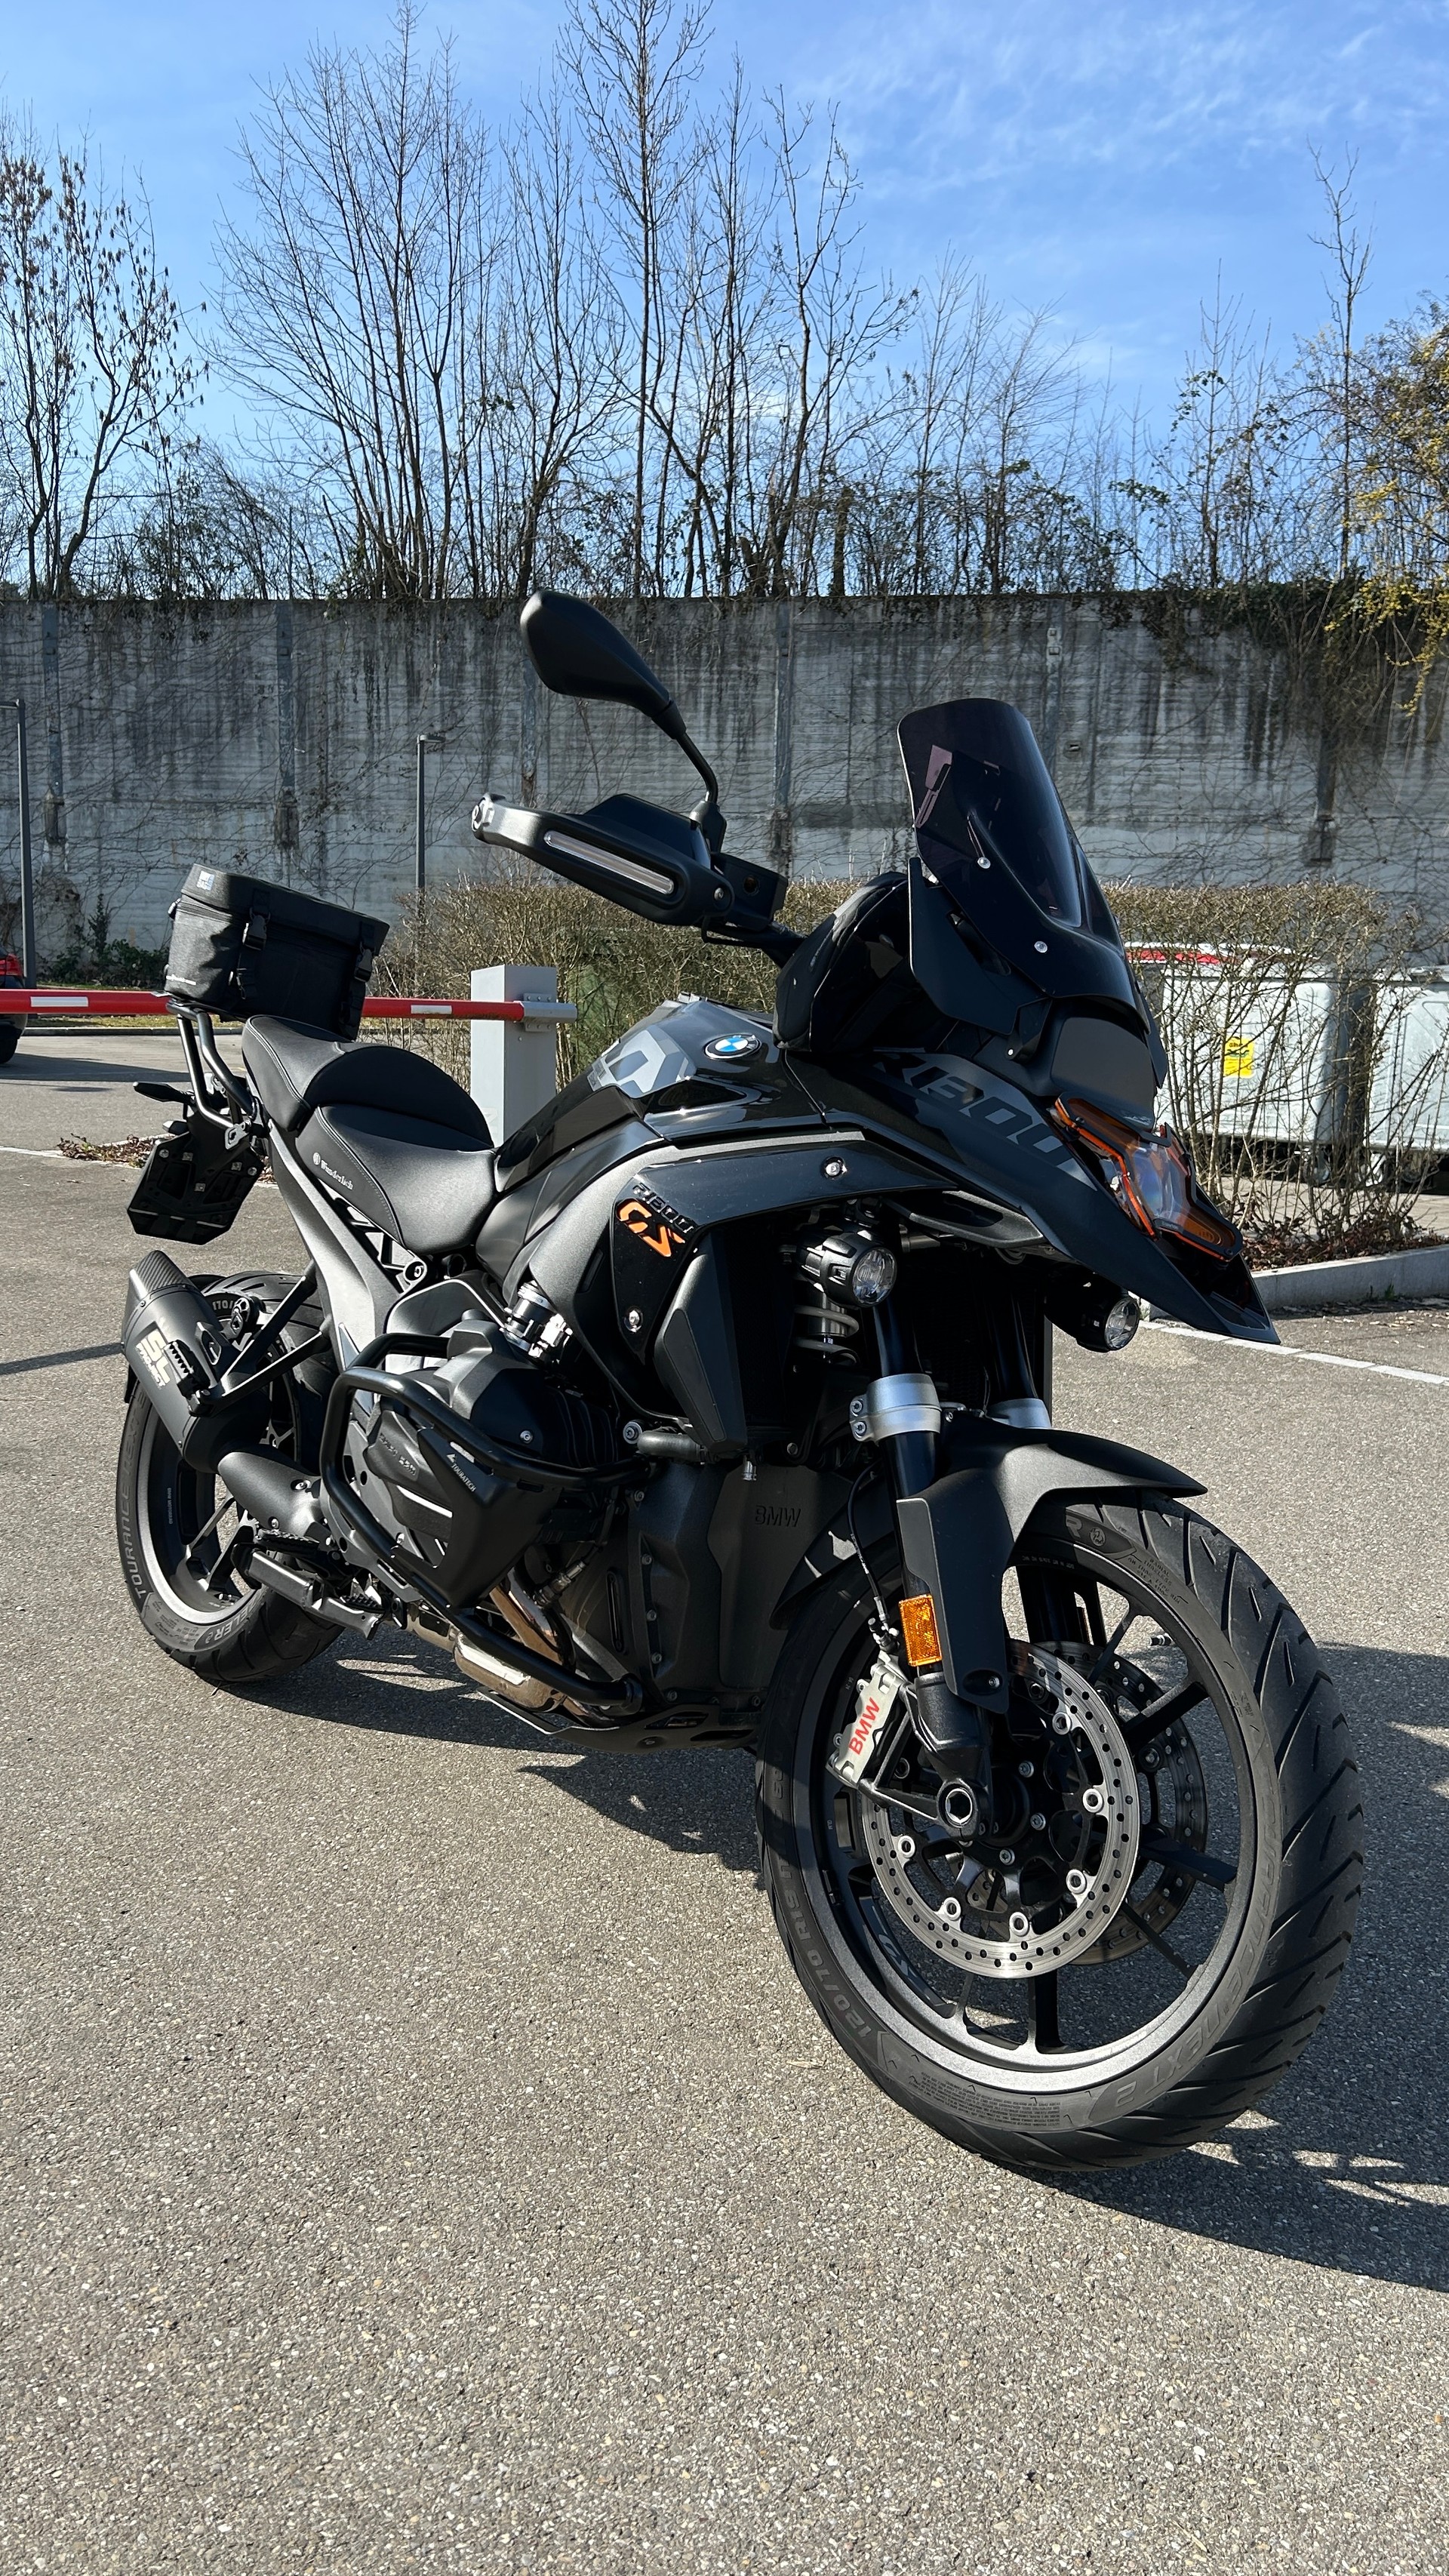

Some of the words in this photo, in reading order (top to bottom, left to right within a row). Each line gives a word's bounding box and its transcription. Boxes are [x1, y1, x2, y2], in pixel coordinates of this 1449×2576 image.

[619, 1201, 686, 1257] GS
[212, 1300, 234, 1310] 170/
[451, 1463, 476, 1492] TOURATECH
[119, 1484, 147, 1599] TOURANCE
[755, 1504, 801, 1527] BMW
[848, 1697, 880, 1755] BMW
[785, 1889, 812, 1940] R19
[808, 1949, 872, 2038] 120/70
